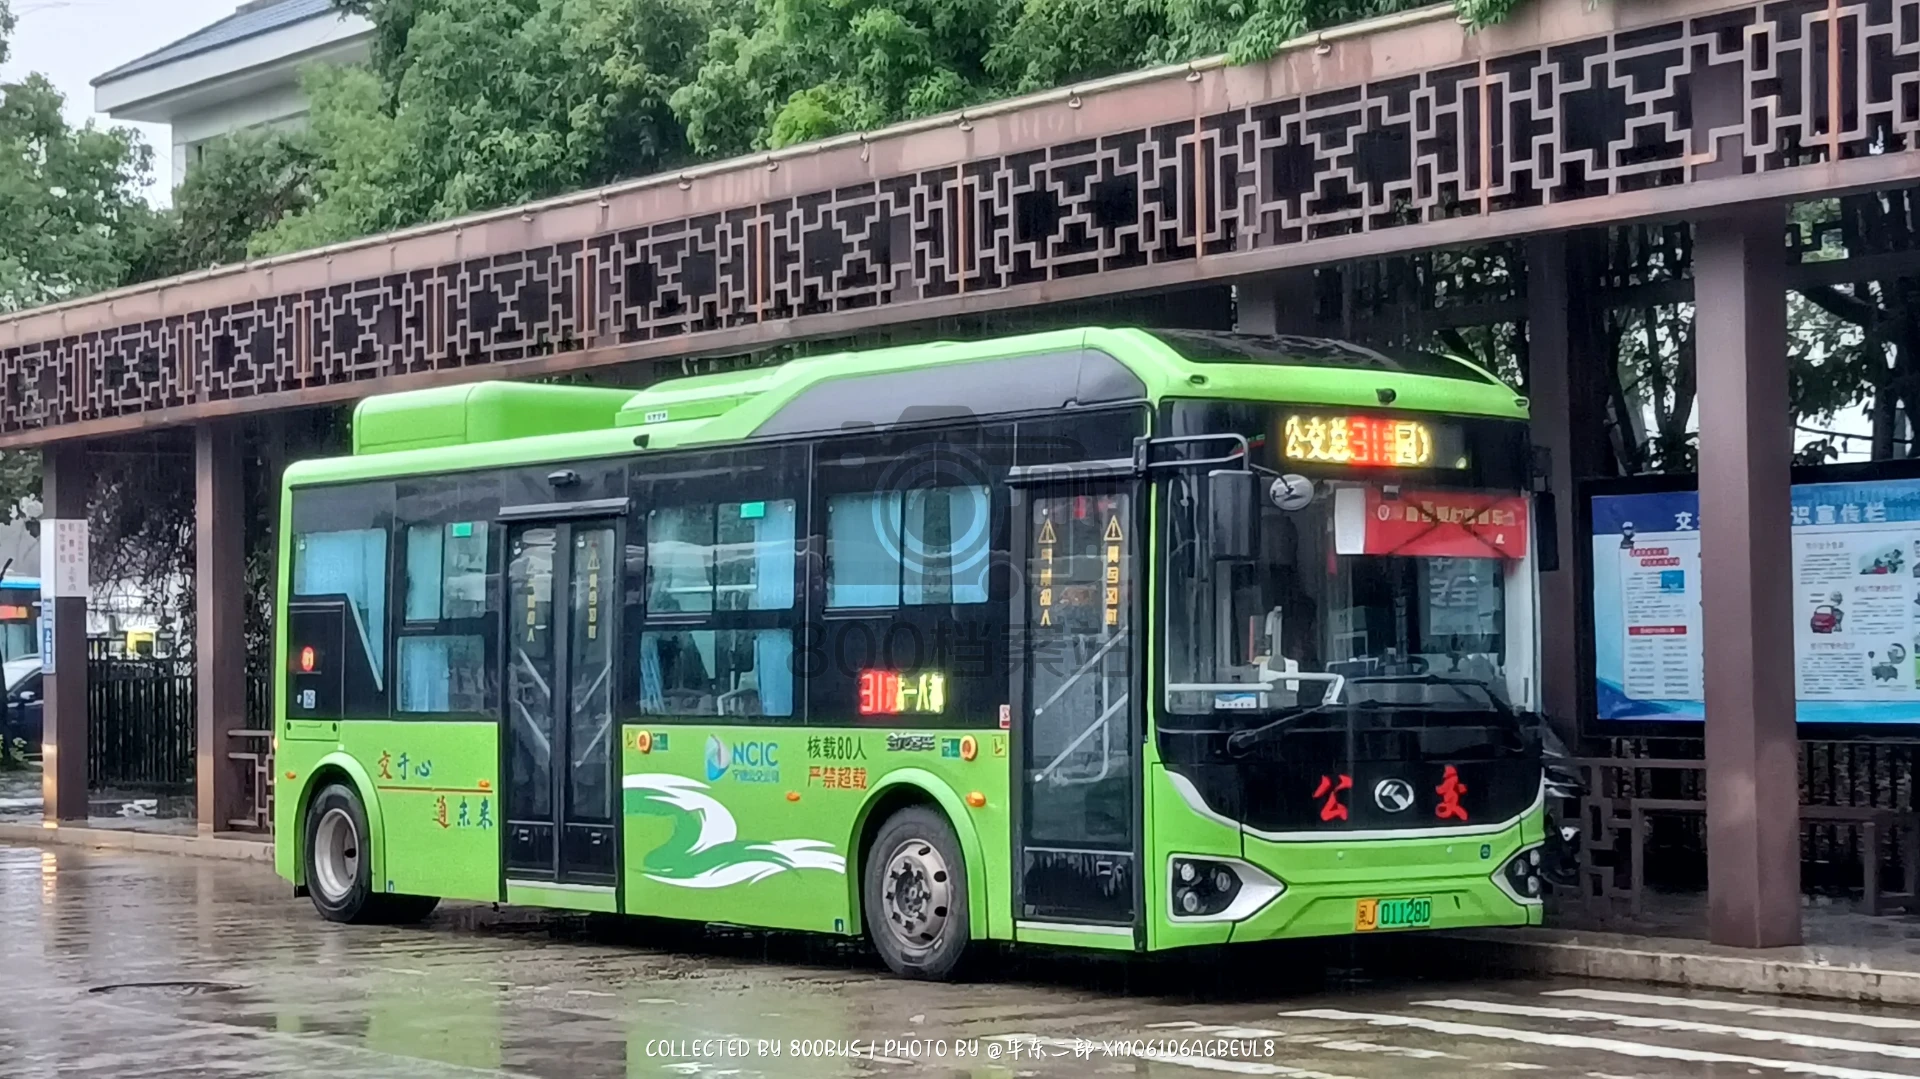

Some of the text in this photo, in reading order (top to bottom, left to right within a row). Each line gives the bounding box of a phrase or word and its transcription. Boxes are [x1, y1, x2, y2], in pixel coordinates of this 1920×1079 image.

[732, 741, 779, 767] NCIC
[807, 735, 868, 761] 核载80人
[807, 765, 868, 790] 严禁超载
[1312, 764, 1469, 821] 公 交
